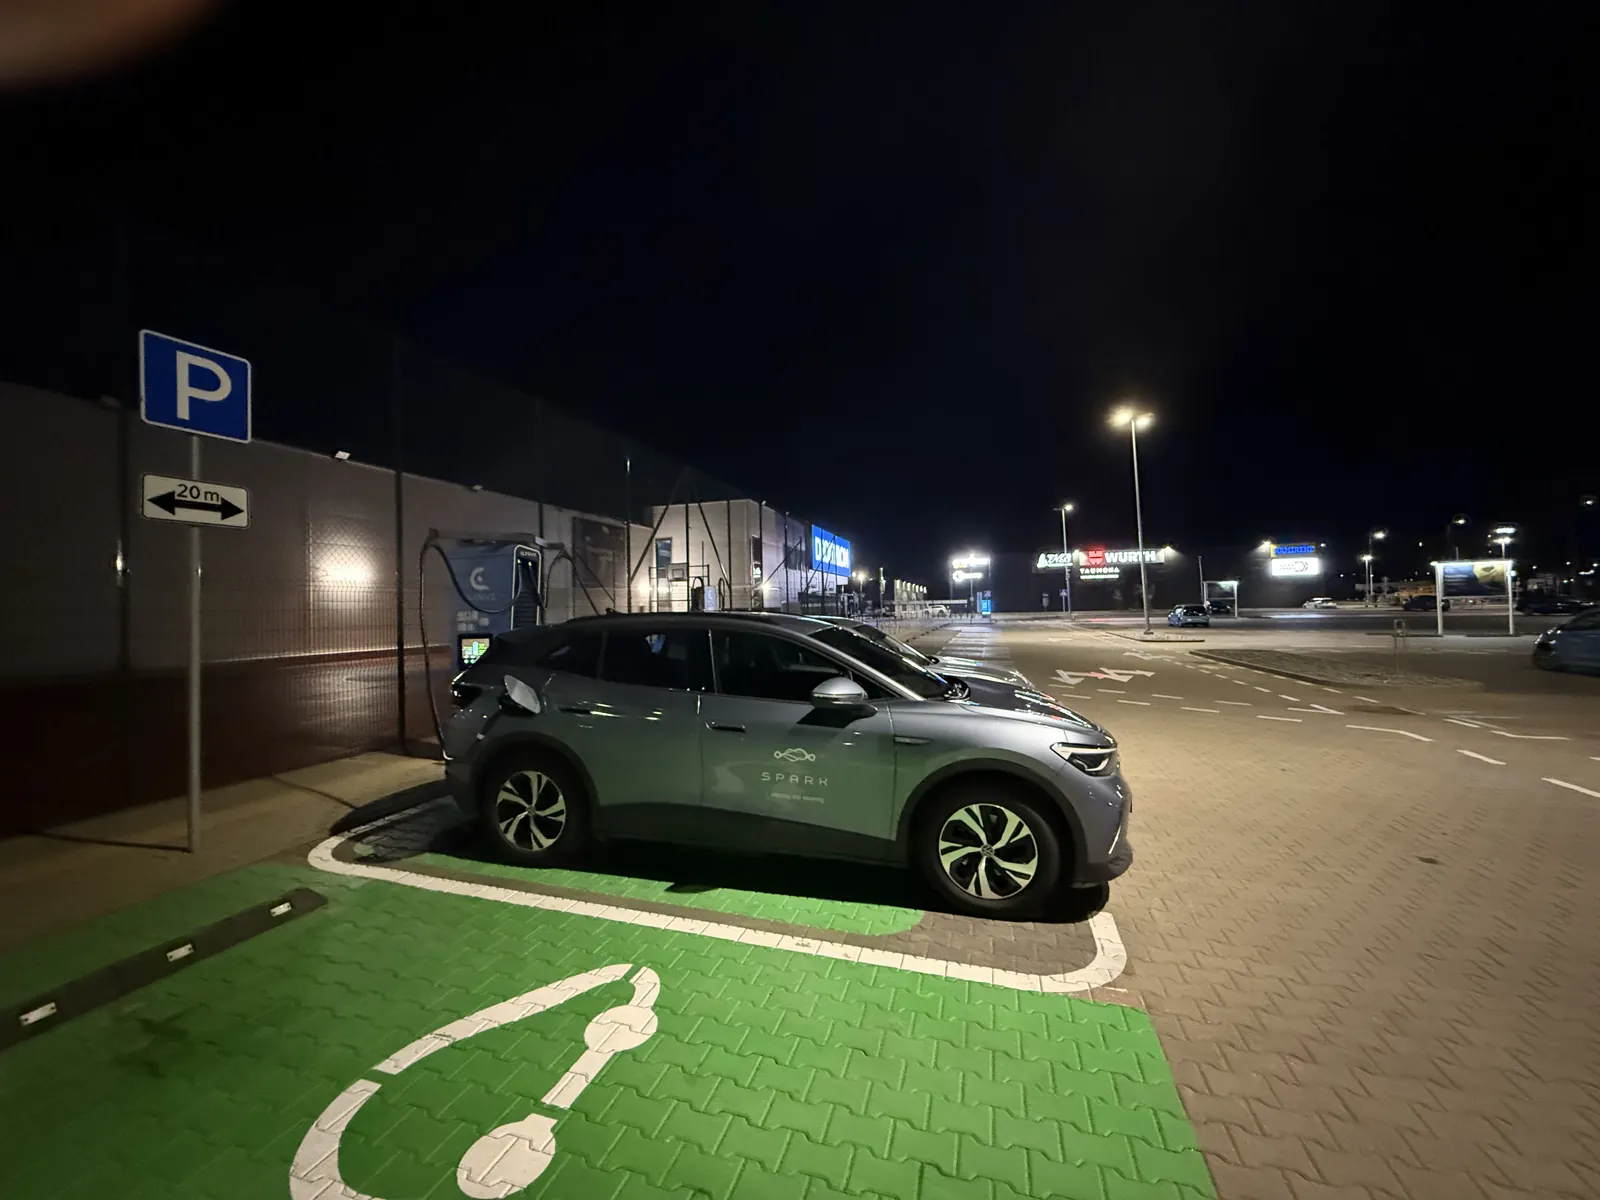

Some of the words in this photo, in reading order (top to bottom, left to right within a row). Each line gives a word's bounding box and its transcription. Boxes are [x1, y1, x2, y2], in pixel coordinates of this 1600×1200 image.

[176, 350, 232, 421] P
[177, 483, 200, 499] 20
[204, 490, 220, 502] m
[760, 772, 828, 786] SPARK
